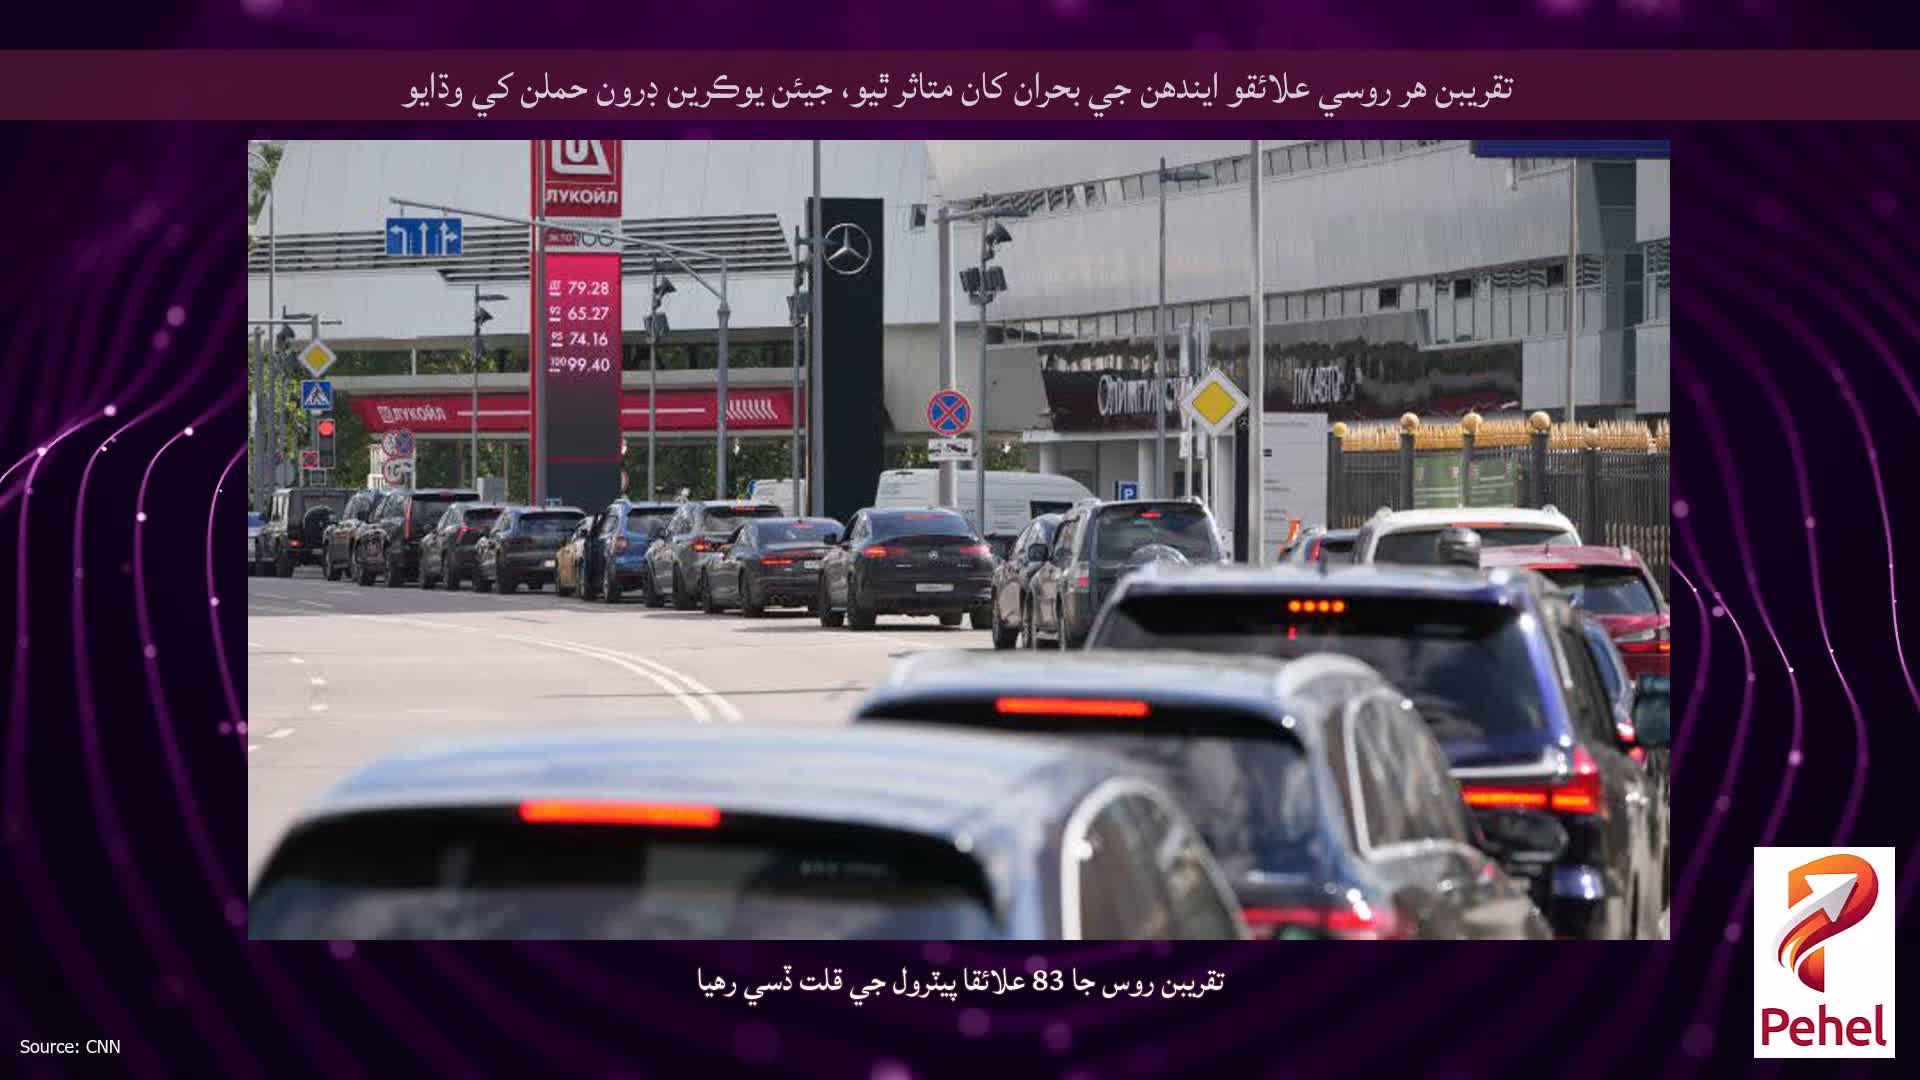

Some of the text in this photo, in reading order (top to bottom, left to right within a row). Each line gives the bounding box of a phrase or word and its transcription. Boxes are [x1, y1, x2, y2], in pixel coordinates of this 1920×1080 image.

[545, 188, 618, 205] ЛУКОЙЛ
[568, 281, 610, 297] 79.28
[549, 306, 610, 321] 92 65.27
[551, 331, 609, 347] 95 74.16
[567, 357, 610, 372] 99.40
